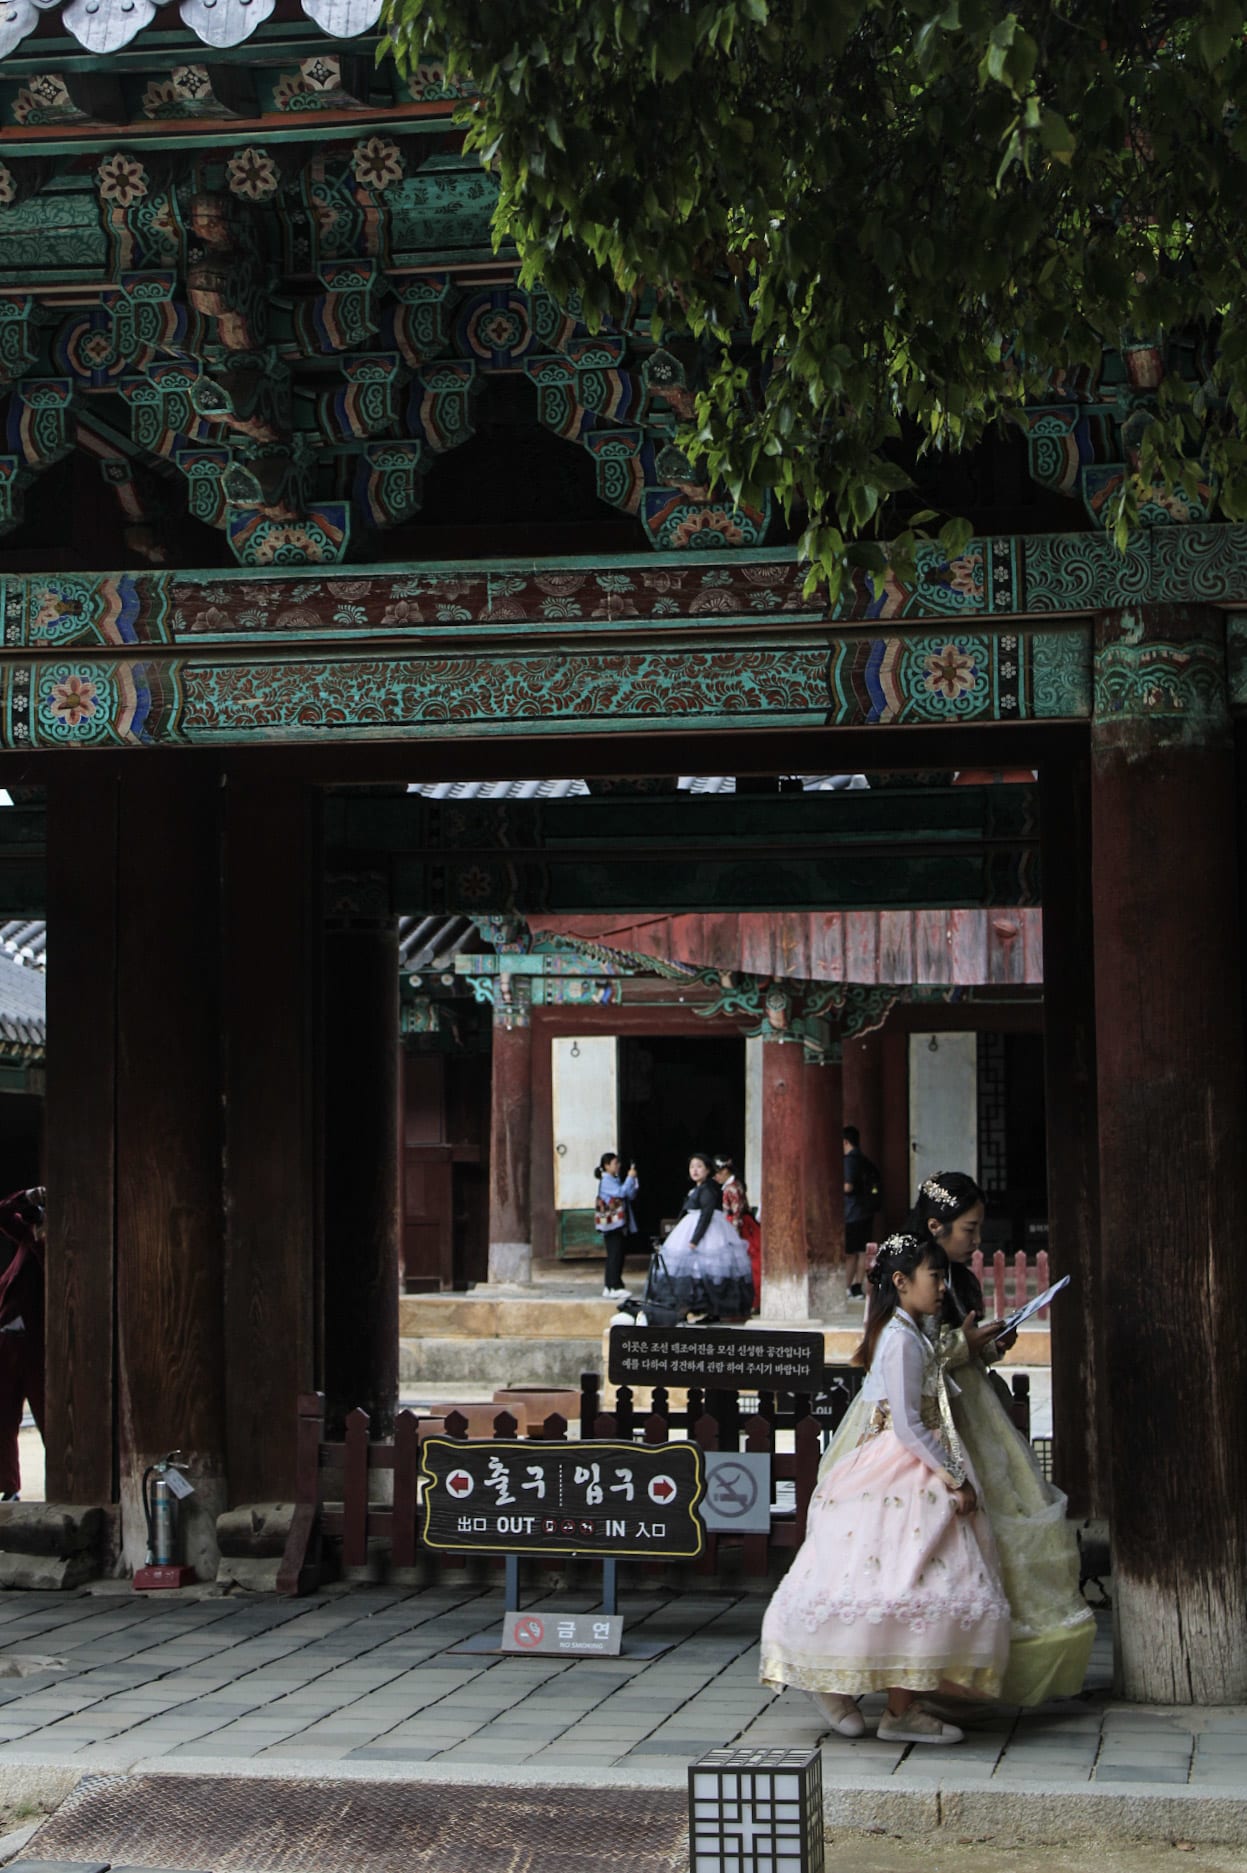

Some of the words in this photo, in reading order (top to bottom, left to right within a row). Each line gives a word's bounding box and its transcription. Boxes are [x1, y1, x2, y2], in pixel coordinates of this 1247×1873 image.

[621, 1340, 649, 1354] 이곳은
[650, 1341, 669, 1354] 조선
[671, 1342, 714, 1356] 태조어진을
[717, 1344, 736, 1357] 모신
[738, 1344, 764, 1358] 신성한
[766, 1346, 811, 1359] 공간입니다
[621, 1358, 640, 1371] 예를
[641, 1360, 668, 1372] 다하여
[669, 1360, 704, 1373] 경건하게
[706, 1362, 724, 1374] 관람
[726, 1362, 745, 1374] 하여
[746, 1362, 773, 1376] 주시기
[774, 1363, 810, 1377] 바랍니다
[483, 1456, 546, 1506] 출구
[573, 1462, 635, 1506] 입구
[457, 1516, 487, 1532] 出口
[496, 1516, 536, 1535] OUT
[605, 1519, 626, 1537] IN
[635, 1521, 666, 1538] 入口
